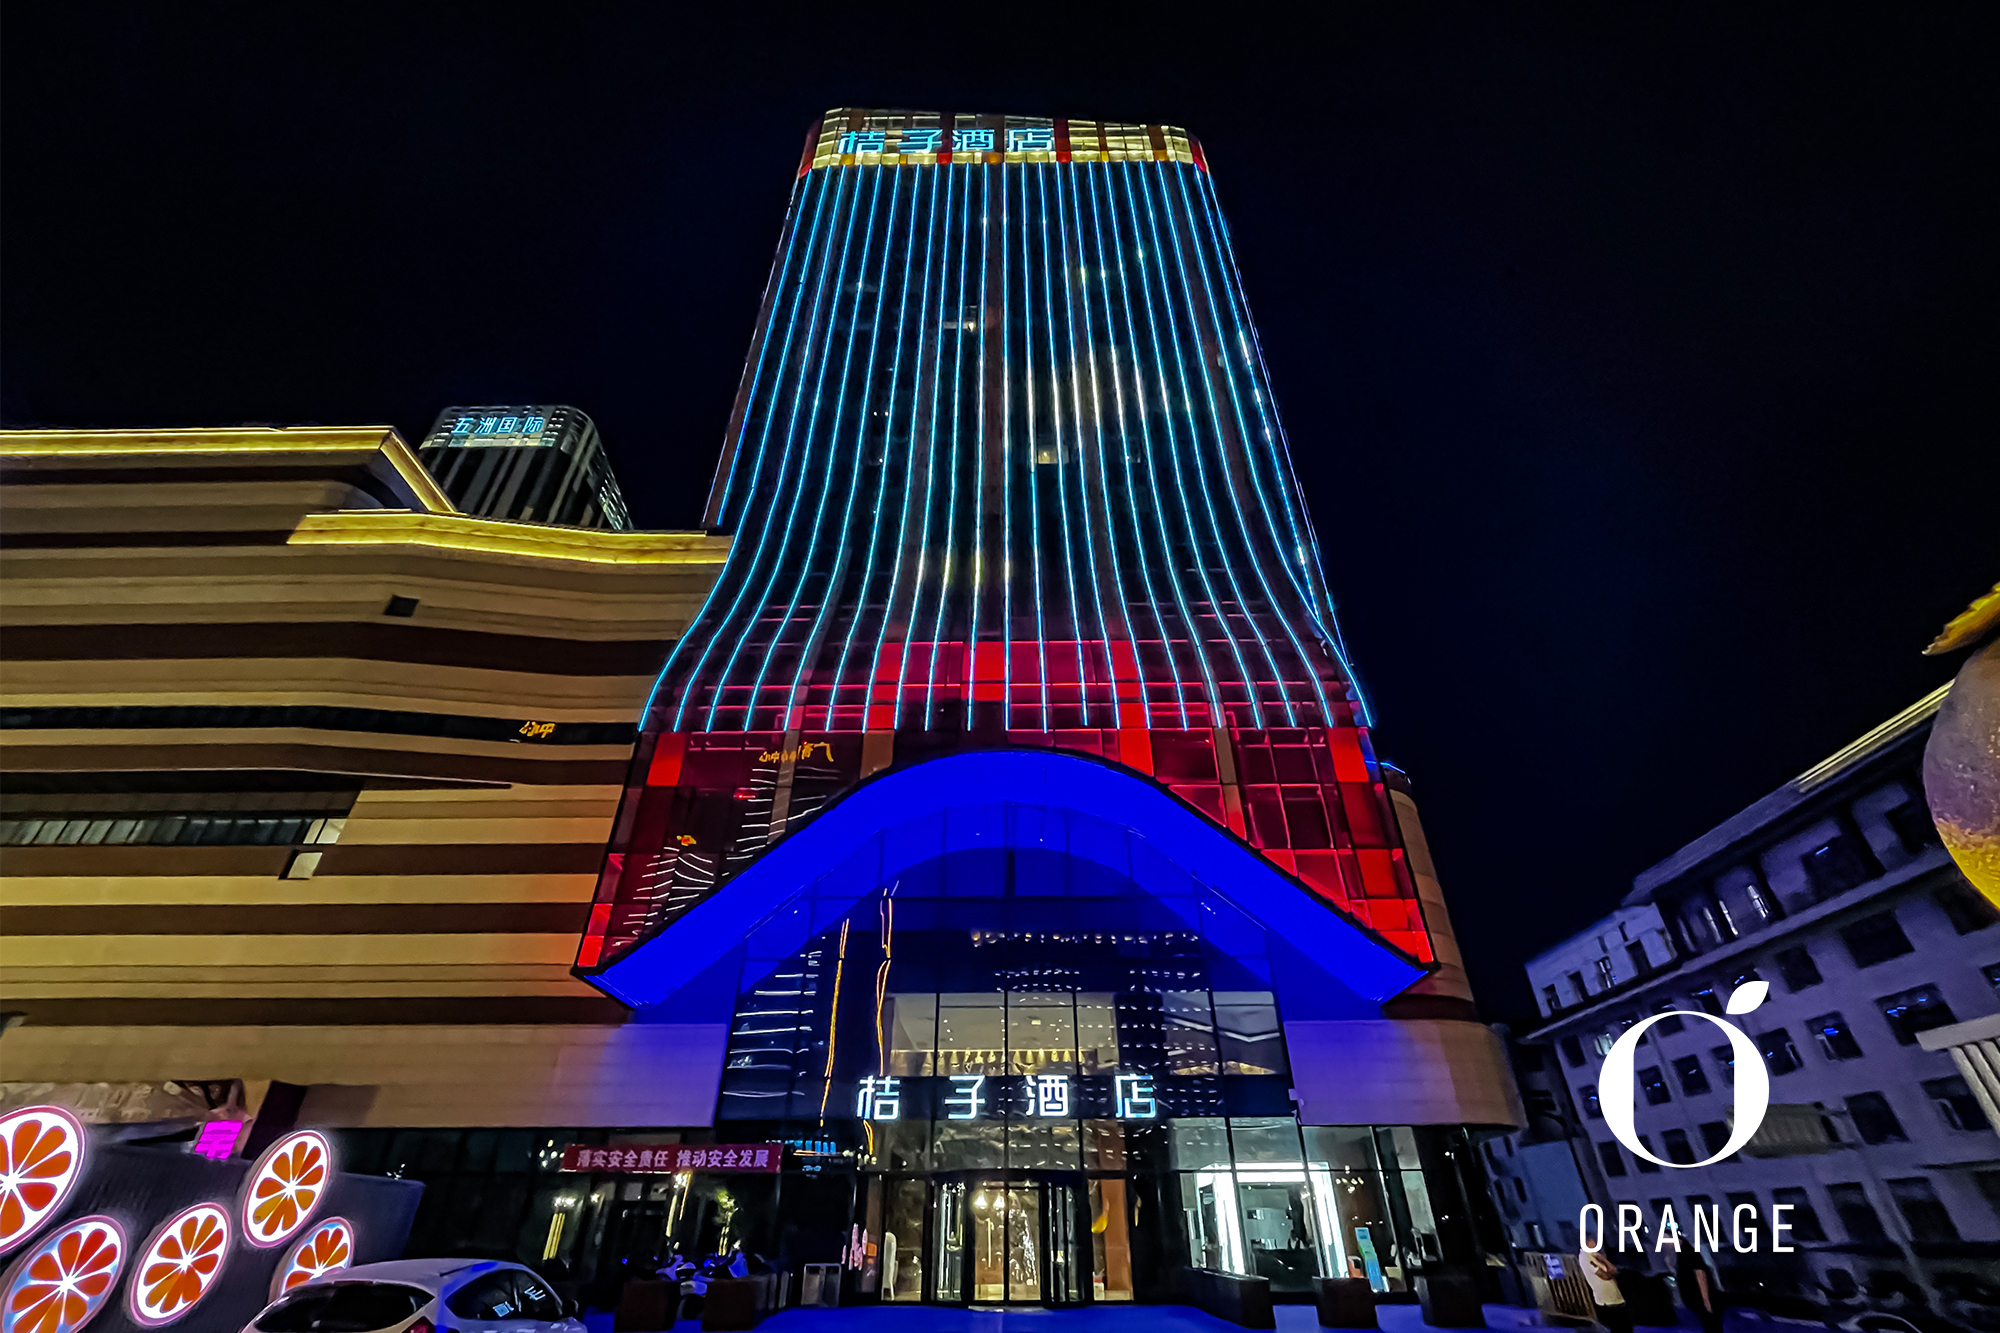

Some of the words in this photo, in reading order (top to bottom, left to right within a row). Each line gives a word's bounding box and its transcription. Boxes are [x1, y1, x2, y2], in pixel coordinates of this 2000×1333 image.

[837, 127, 1055, 154] 桔子酒店
[451, 416, 544, 434] 五洲国际
[856, 1074, 1157, 1120] 桔子酒店
[676, 1149, 769, 1168] 推动安全发展
